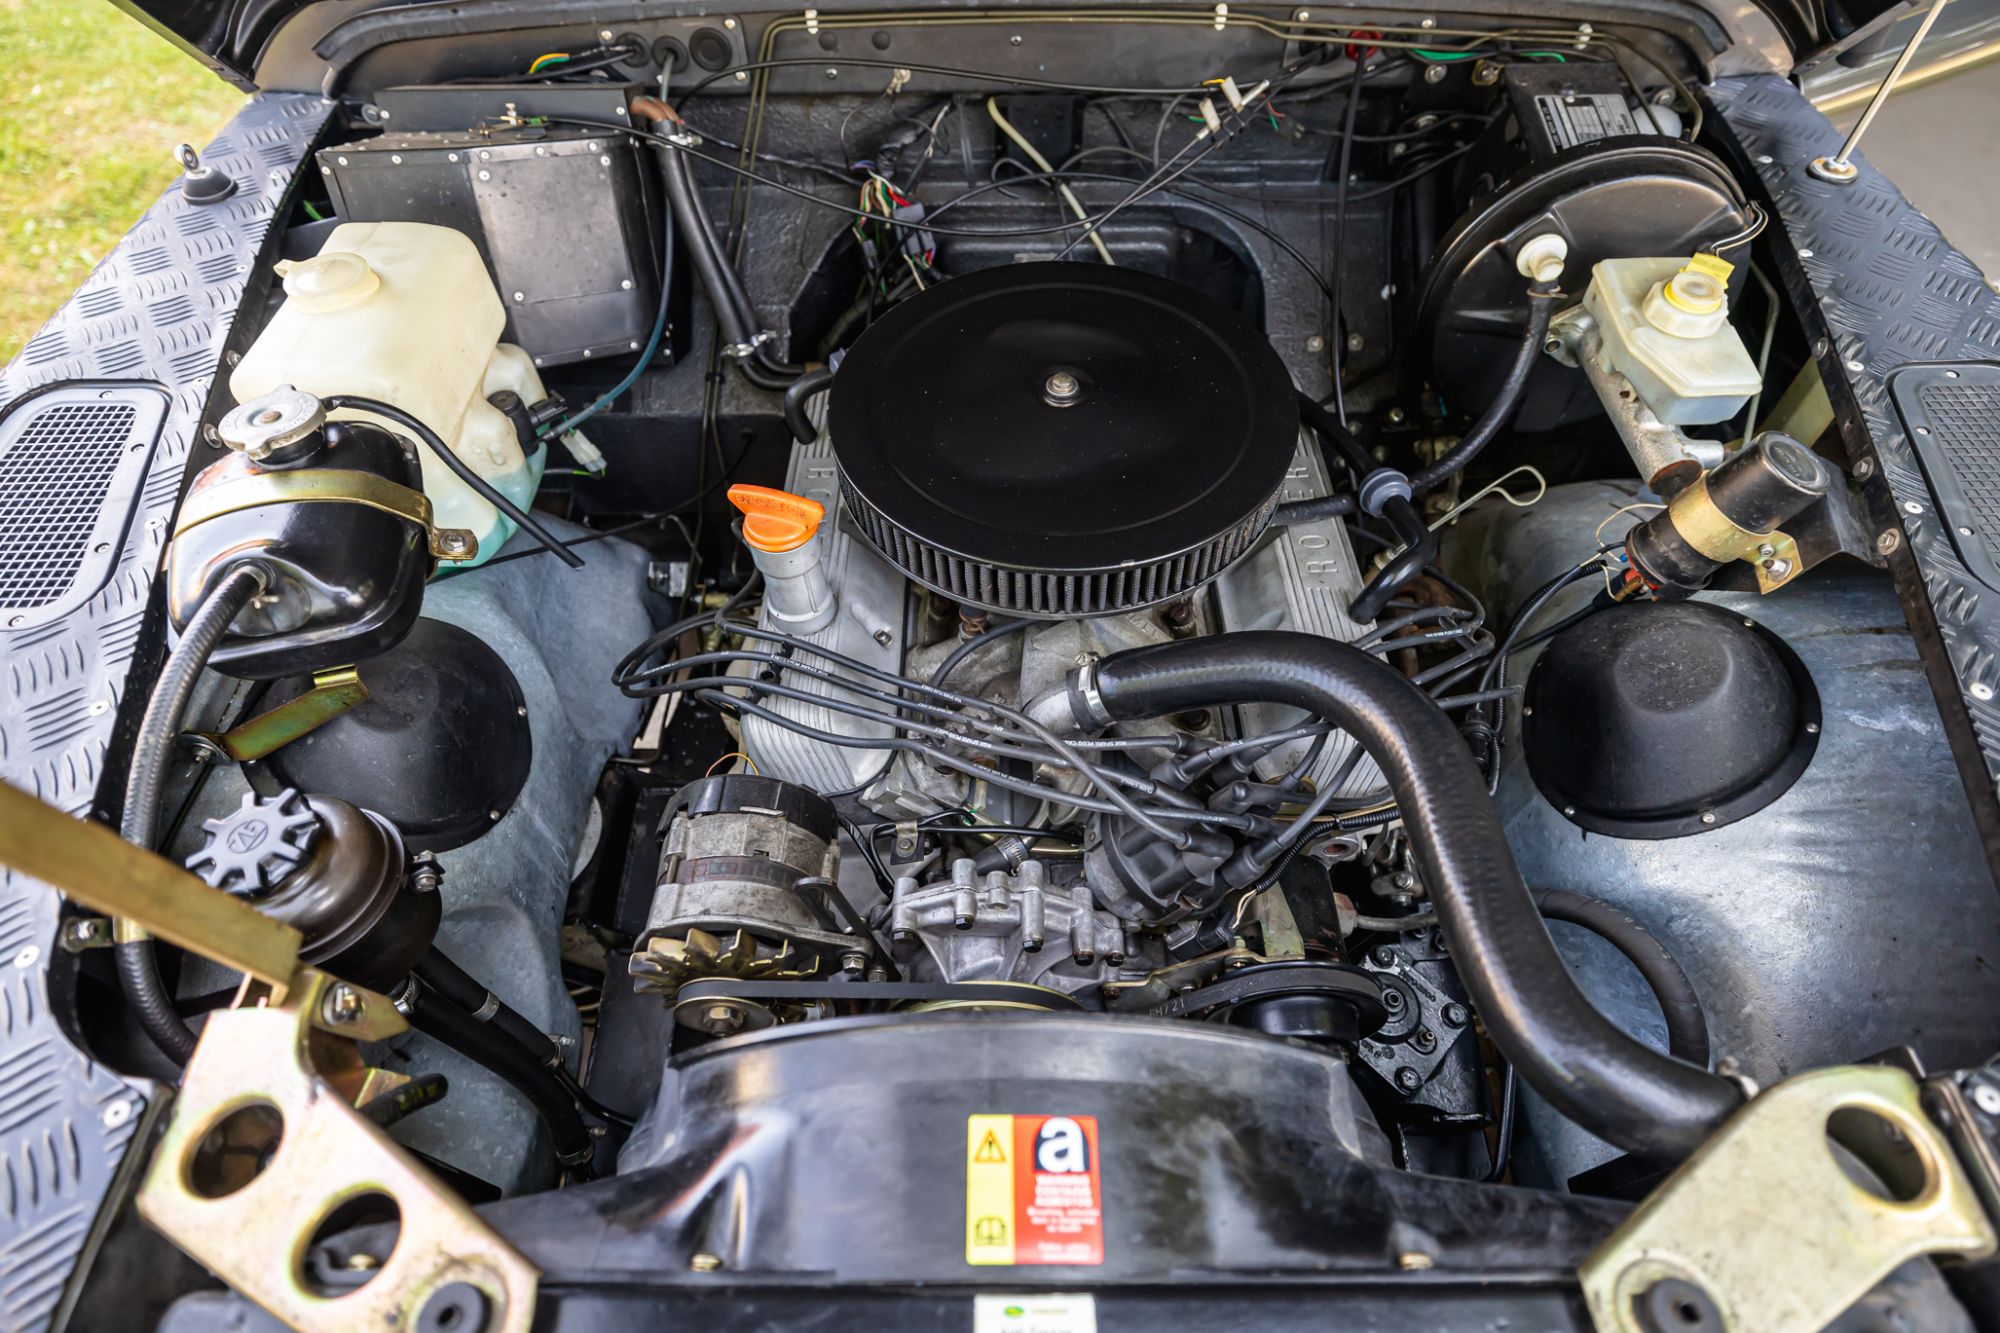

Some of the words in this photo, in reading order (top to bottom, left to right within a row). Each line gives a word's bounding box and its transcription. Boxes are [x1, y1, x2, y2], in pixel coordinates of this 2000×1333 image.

[736, 495, 785, 512] ENGINE
[788, 505, 809, 519] OIL
[1283, 466, 1339, 575] ROER
